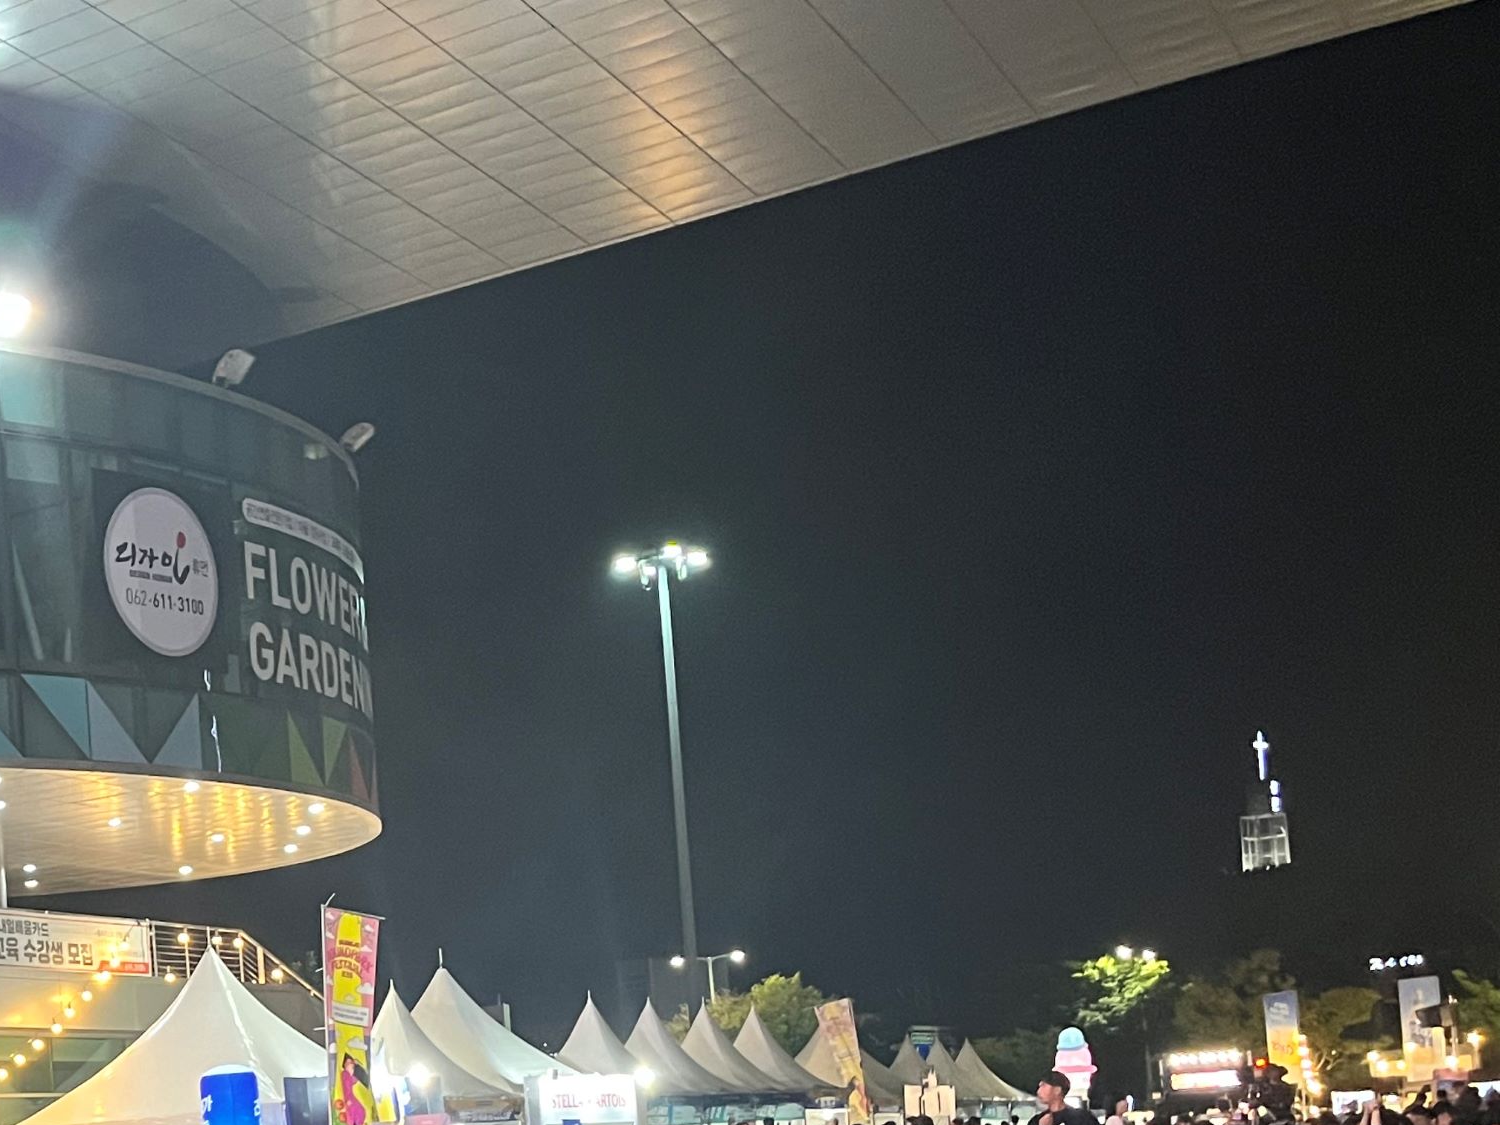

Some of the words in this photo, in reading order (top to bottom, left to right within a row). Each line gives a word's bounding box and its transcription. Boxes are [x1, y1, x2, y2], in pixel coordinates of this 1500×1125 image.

[244, 541, 368, 652] FLOWER
[251, 621, 374, 723] GARDEN
[24, 939, 64, 965] 수강생
[68, 943, 94, 966] 모집
